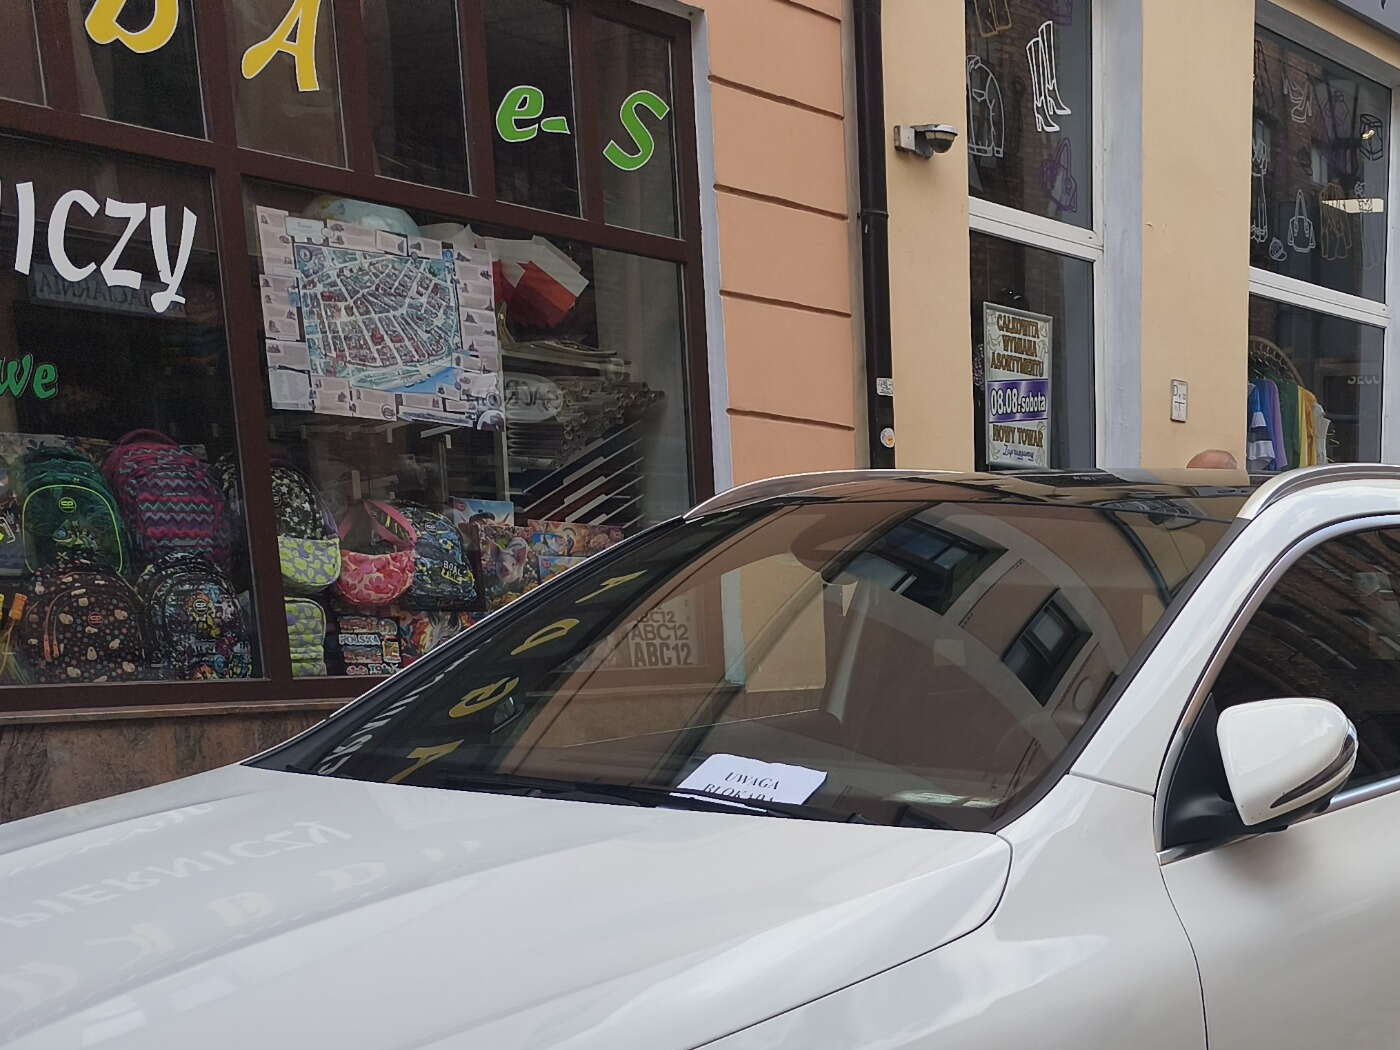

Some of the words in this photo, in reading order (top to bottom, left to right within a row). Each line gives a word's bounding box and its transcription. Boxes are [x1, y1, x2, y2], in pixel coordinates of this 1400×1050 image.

[992, 423, 1016, 444] NOWY
[1016, 426, 1044, 449] TOWAR
[631, 623, 689, 641] ABC12
[633, 642, 693, 667] ABC12
[724, 771, 780, 790] UWAGA
